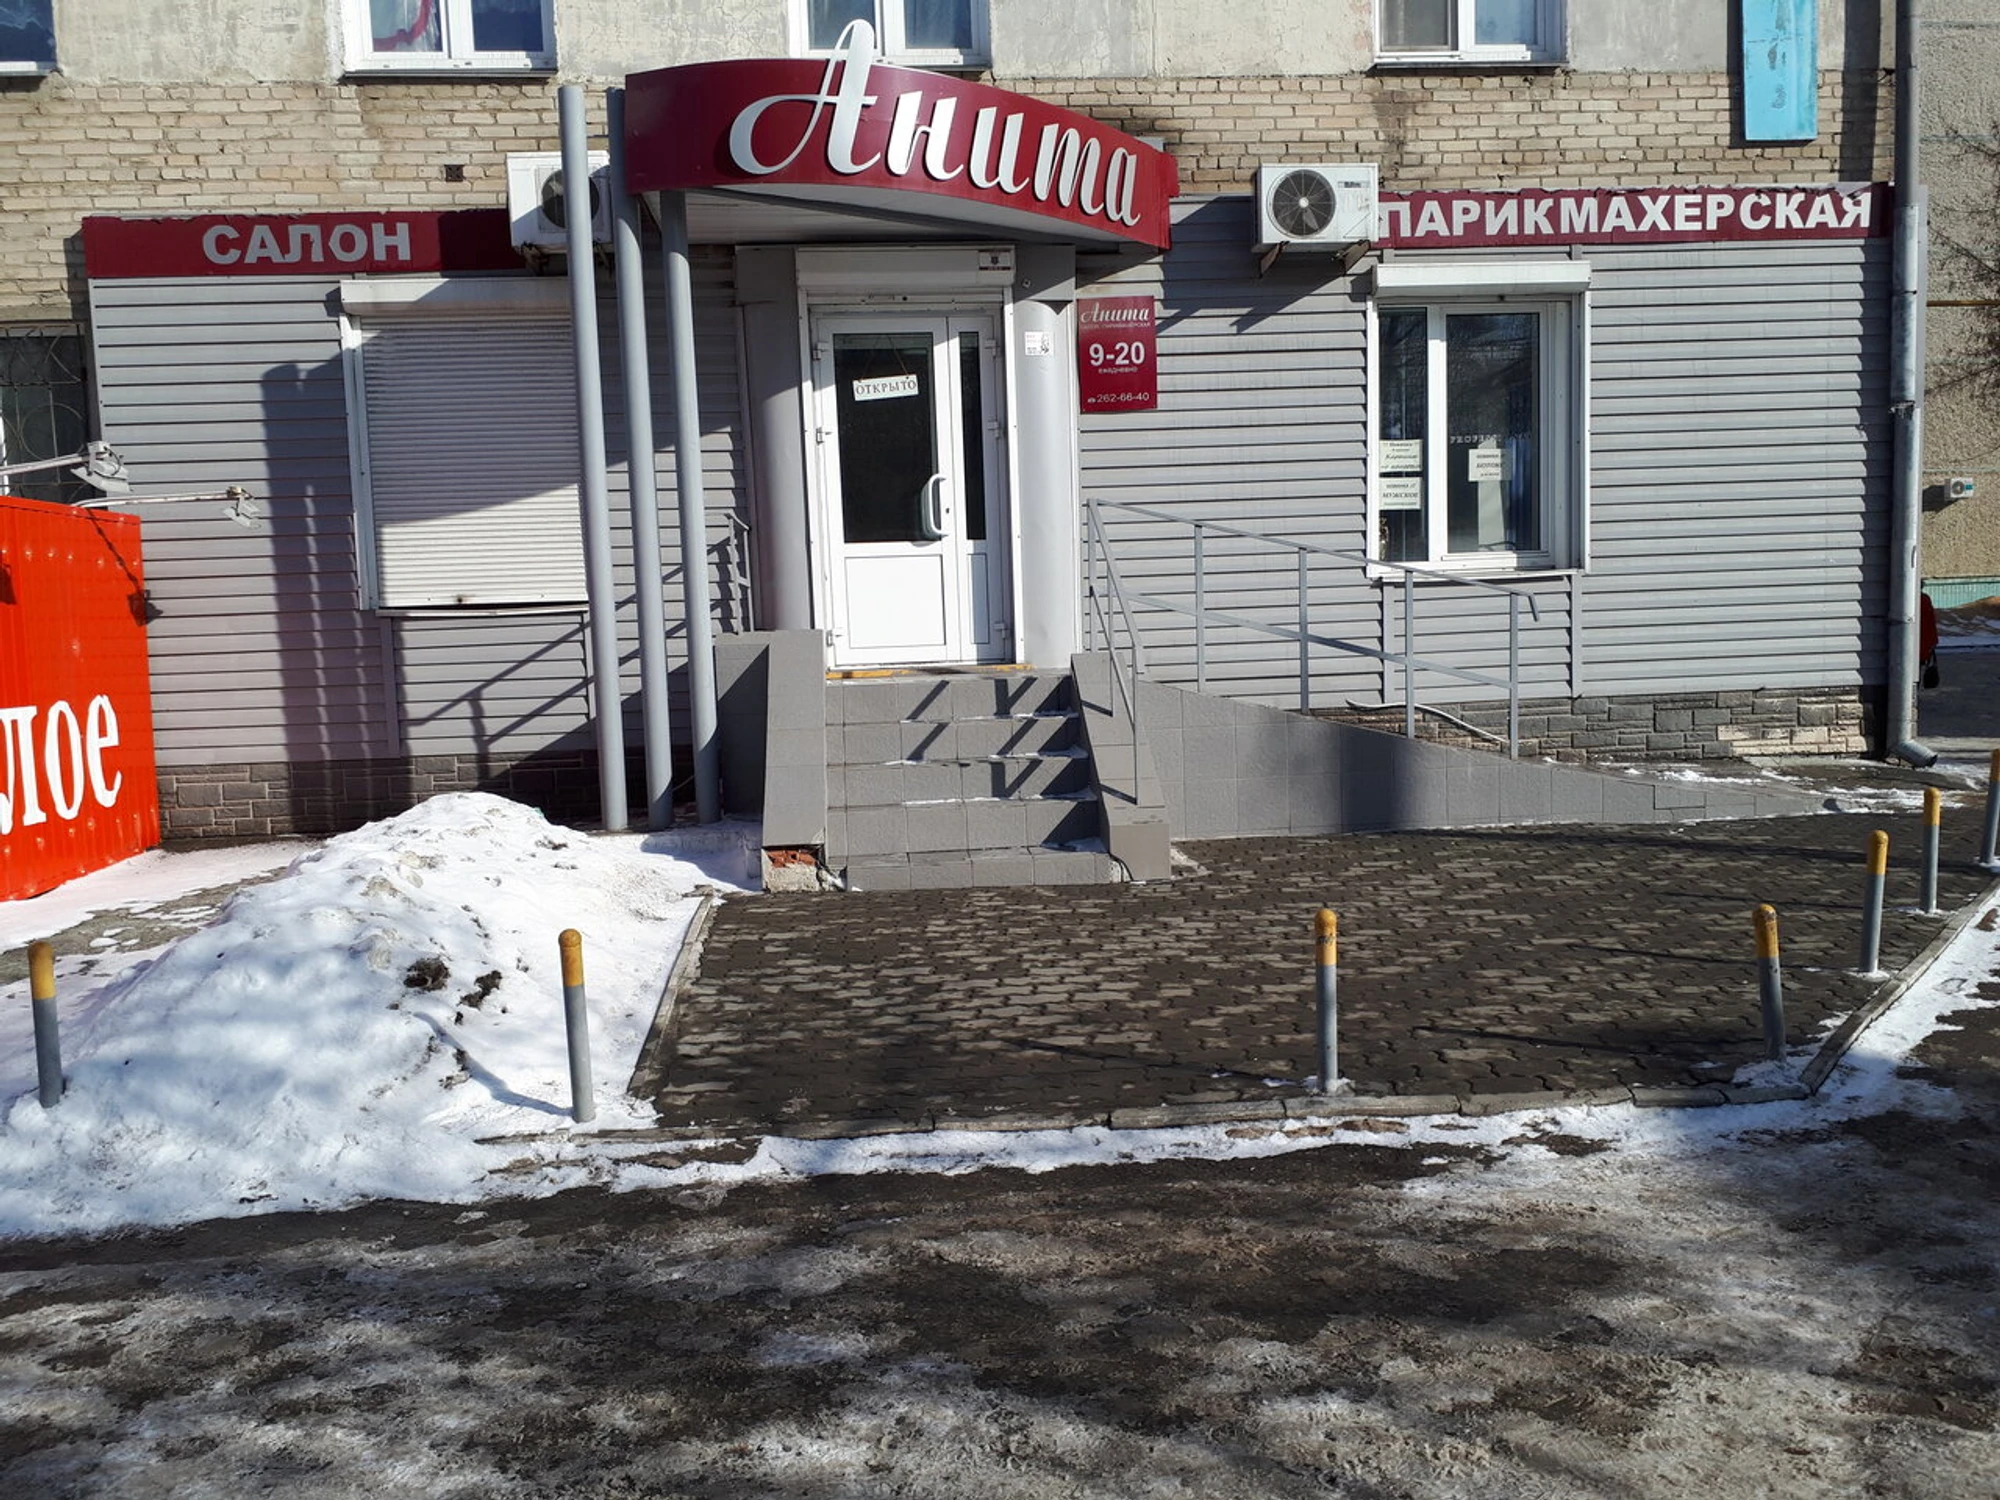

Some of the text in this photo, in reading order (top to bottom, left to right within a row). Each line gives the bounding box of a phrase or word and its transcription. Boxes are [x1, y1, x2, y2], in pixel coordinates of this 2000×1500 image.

[729, 19, 1141, 227] Анита
[1379, 191, 1873, 239] ПАРИКМАХЕРСКАЯ
[202, 222, 411, 265] САЛОН
[1081, 302, 1150, 323] Анита
[1089, 341, 1145, 366] 9-20
[855, 380, 917, 395] ОТКРЫТО
[1097, 391, 1150, 403] 262-66-40
